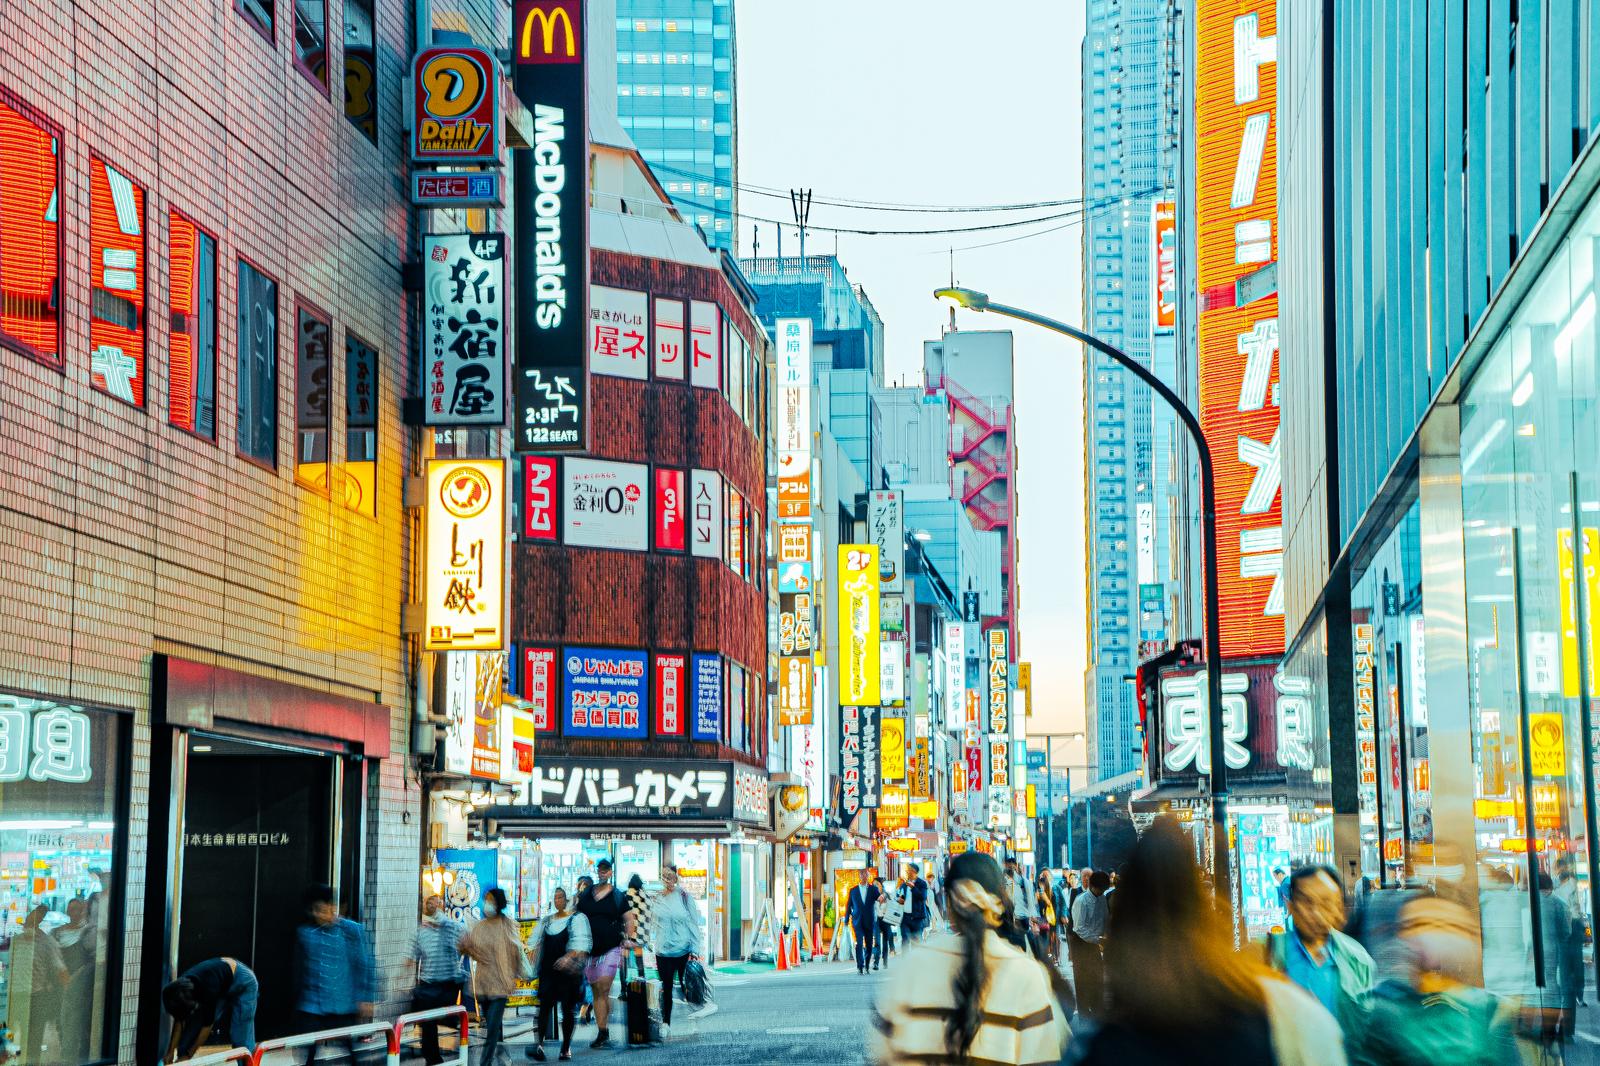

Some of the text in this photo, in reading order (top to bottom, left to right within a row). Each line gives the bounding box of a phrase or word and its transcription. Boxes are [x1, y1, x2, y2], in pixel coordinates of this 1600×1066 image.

[421, 119, 489, 150] Daily
[421, 139, 469, 150] YAMAZAKI
[420, 178, 490, 195] たばこ 酒
[474, 240, 498, 258] 4F
[448, 257, 498, 416] 新宿屋
[786, 322, 801, 382] 桑原ビル
[525, 427, 578, 442] 122 SEATS
[531, 463, 551, 531] アコム
[696, 481, 712, 521] 入口
[779, 482, 809, 494] アコム
[664, 488, 676, 530] 3F
[786, 503, 802, 516] 3F
[780, 526, 809, 535] じゃんぱら
[784, 537, 805, 546] 高価
[784, 549, 805, 558] 買取
[847, 550, 871, 571] 2F
[430, 625, 451, 641] B1
[780, 612, 794, 655] カメラ
[795, 595, 810, 651] ヨドバシ
[583, 658, 644, 677] じゃんぱら
[535, 665, 546, 724] 高価買取
[950, 652, 961, 724] 買取センター
[990, 631, 1007, 734] ヨドバシカメラ
[665, 671, 675, 728] 高価買取
[571, 709, 640, 728] 高価買取
[843, 706, 859, 814] ヨドバシカメラ
[992, 743, 1007, 785] 時計館
[540, 804, 570, 814] Yodobashi
[572, 804, 595, 814] Camera
